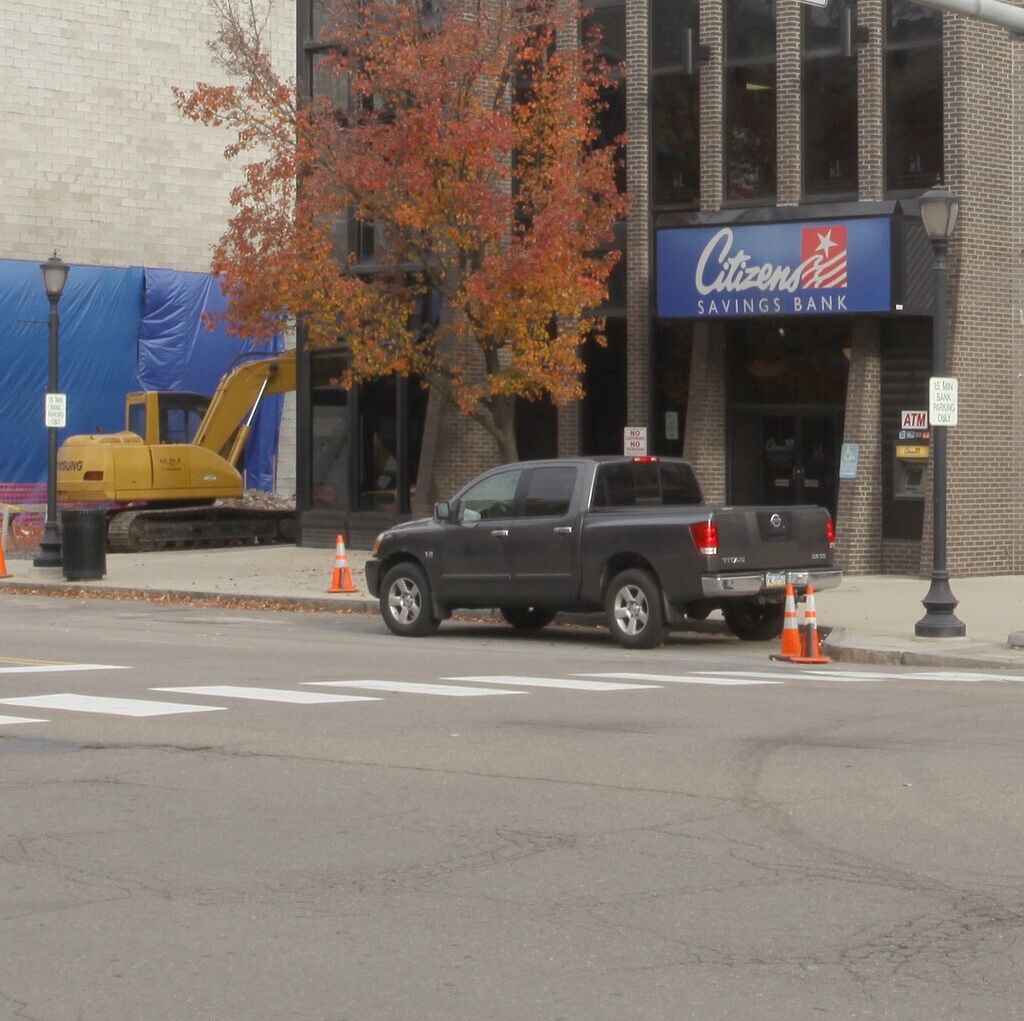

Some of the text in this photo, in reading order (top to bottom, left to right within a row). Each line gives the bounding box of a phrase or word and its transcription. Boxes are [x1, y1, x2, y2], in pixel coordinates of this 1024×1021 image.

[694, 227, 823, 296] Citizens
[697, 294, 848, 315] SAVINGS BANK
[903, 412, 926, 428] ATM
